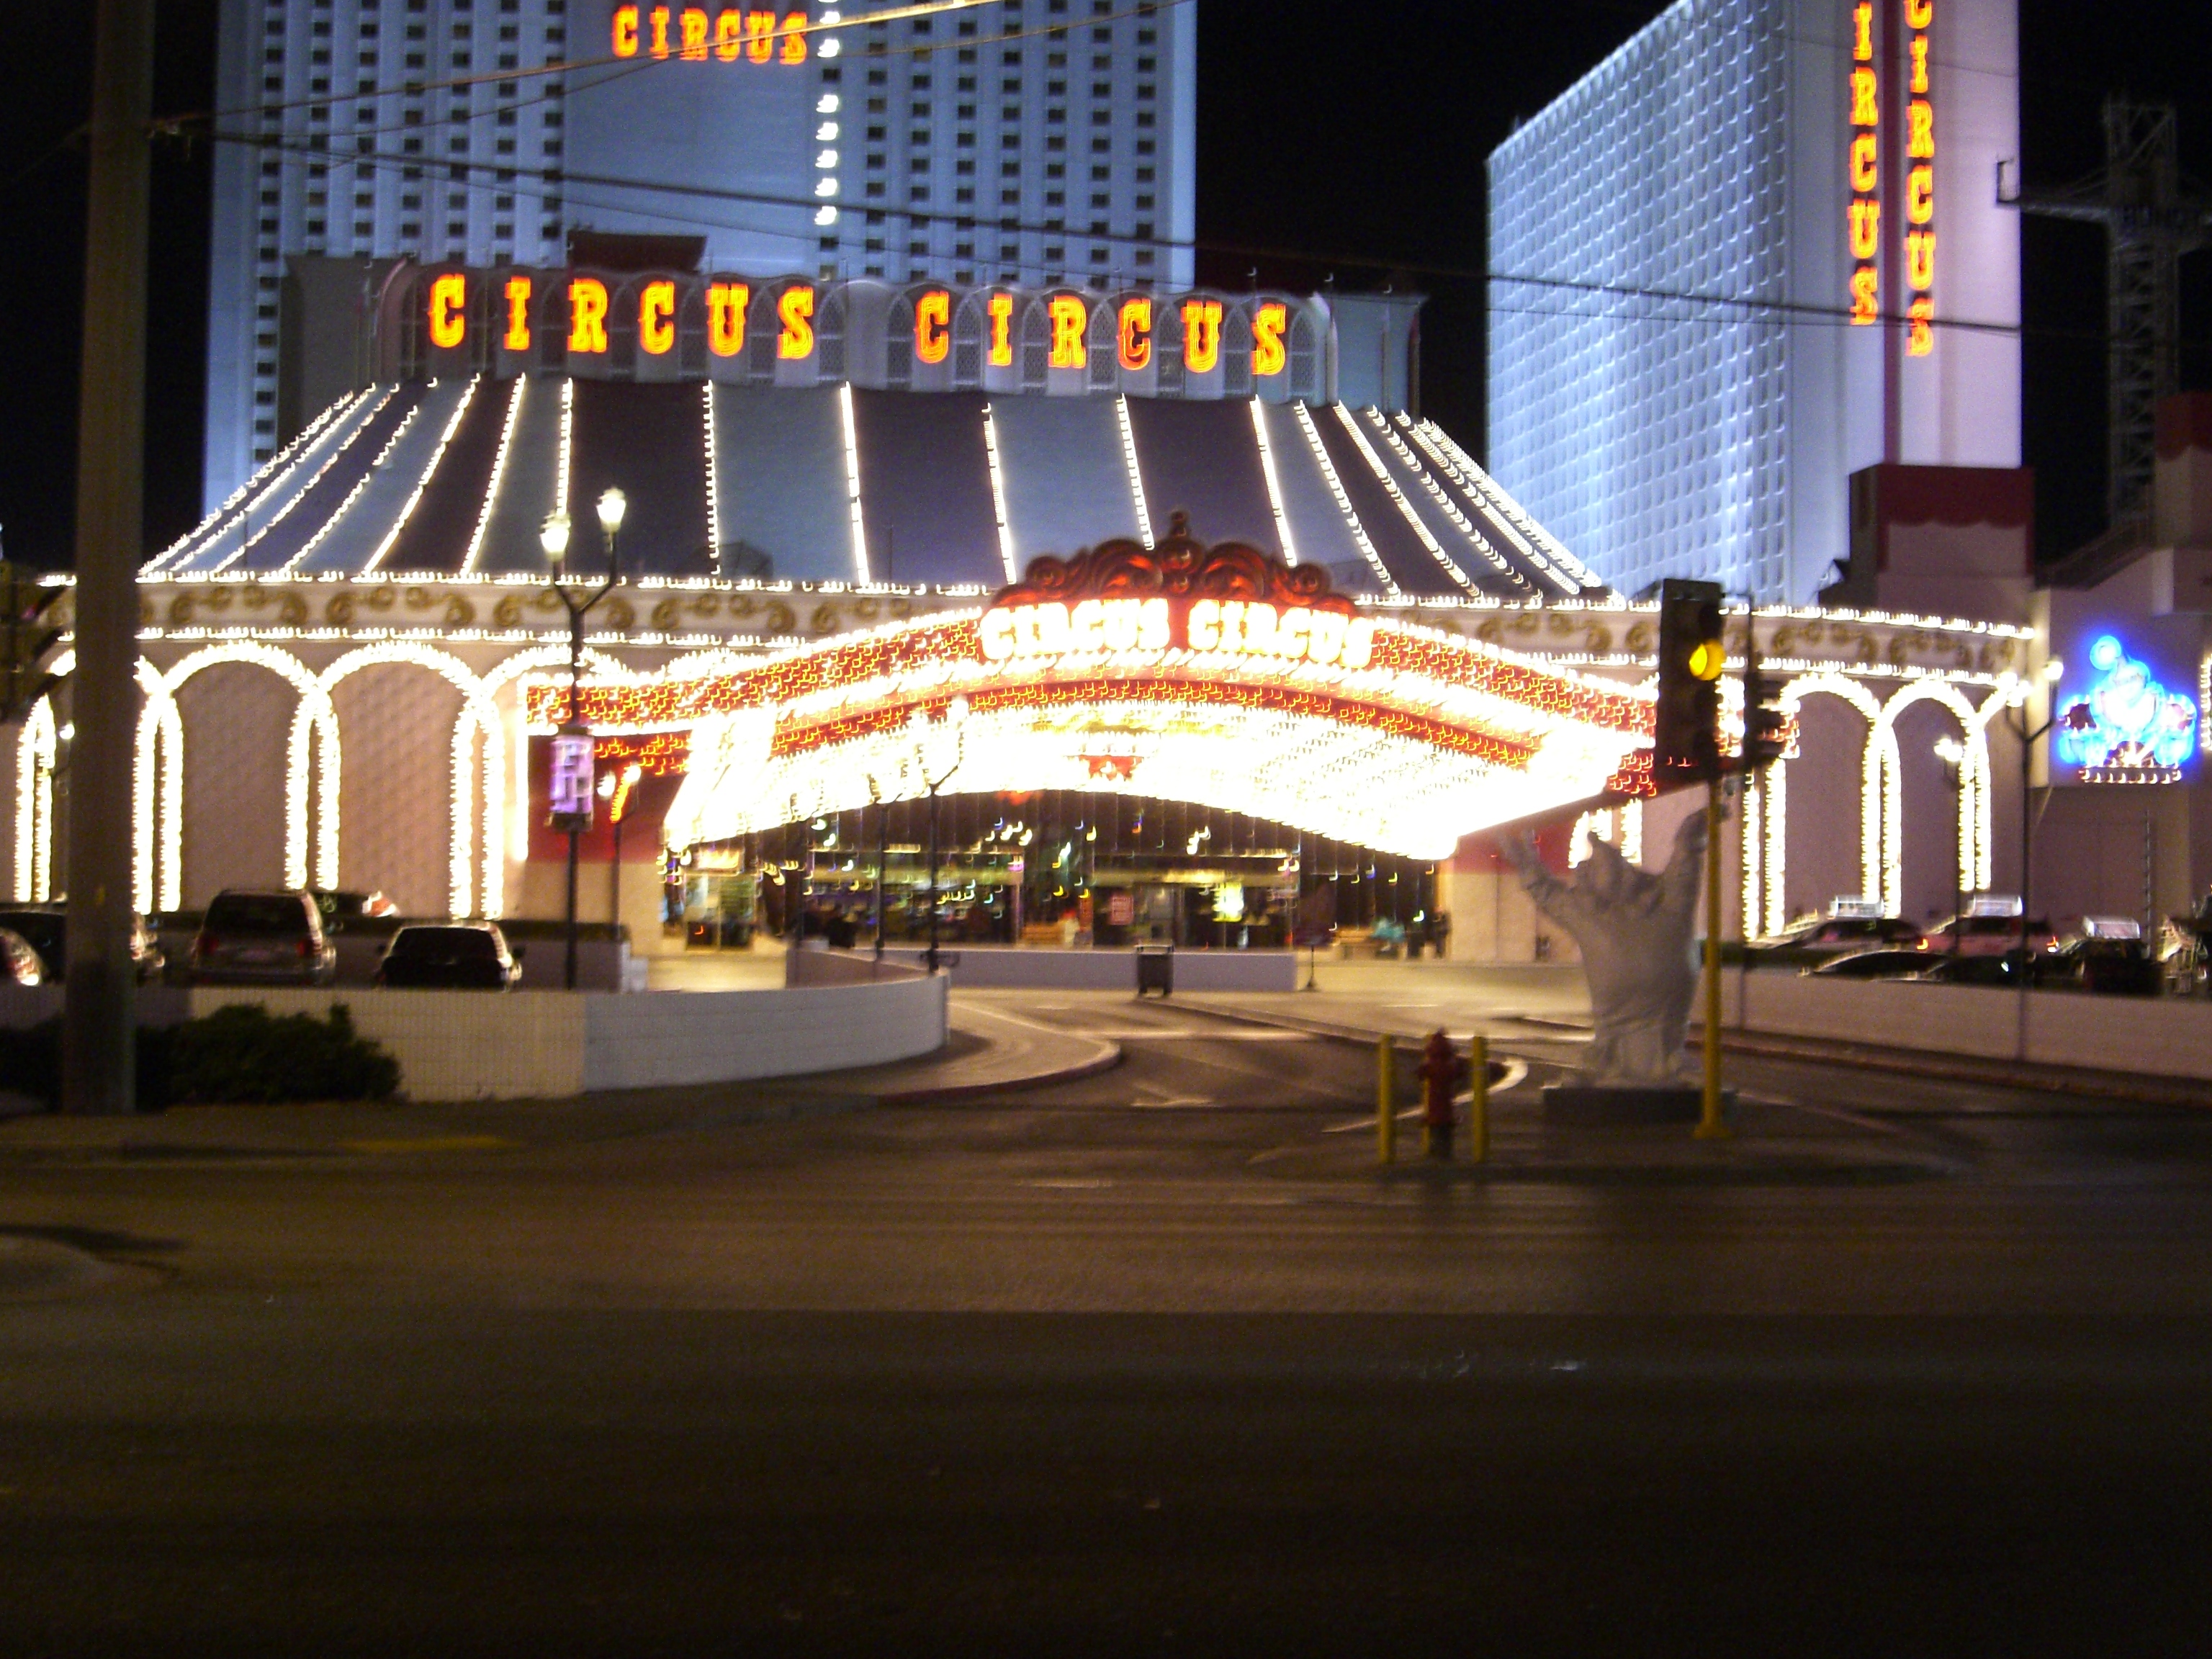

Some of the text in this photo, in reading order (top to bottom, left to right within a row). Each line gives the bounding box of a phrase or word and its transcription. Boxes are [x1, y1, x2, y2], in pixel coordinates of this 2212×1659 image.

[611, 5, 808, 65] CIRCUS
[428, 274, 1286, 375] CIRCUS CIRCUS
[980, 598, 1375, 669] CIRCUS CIRCUS
